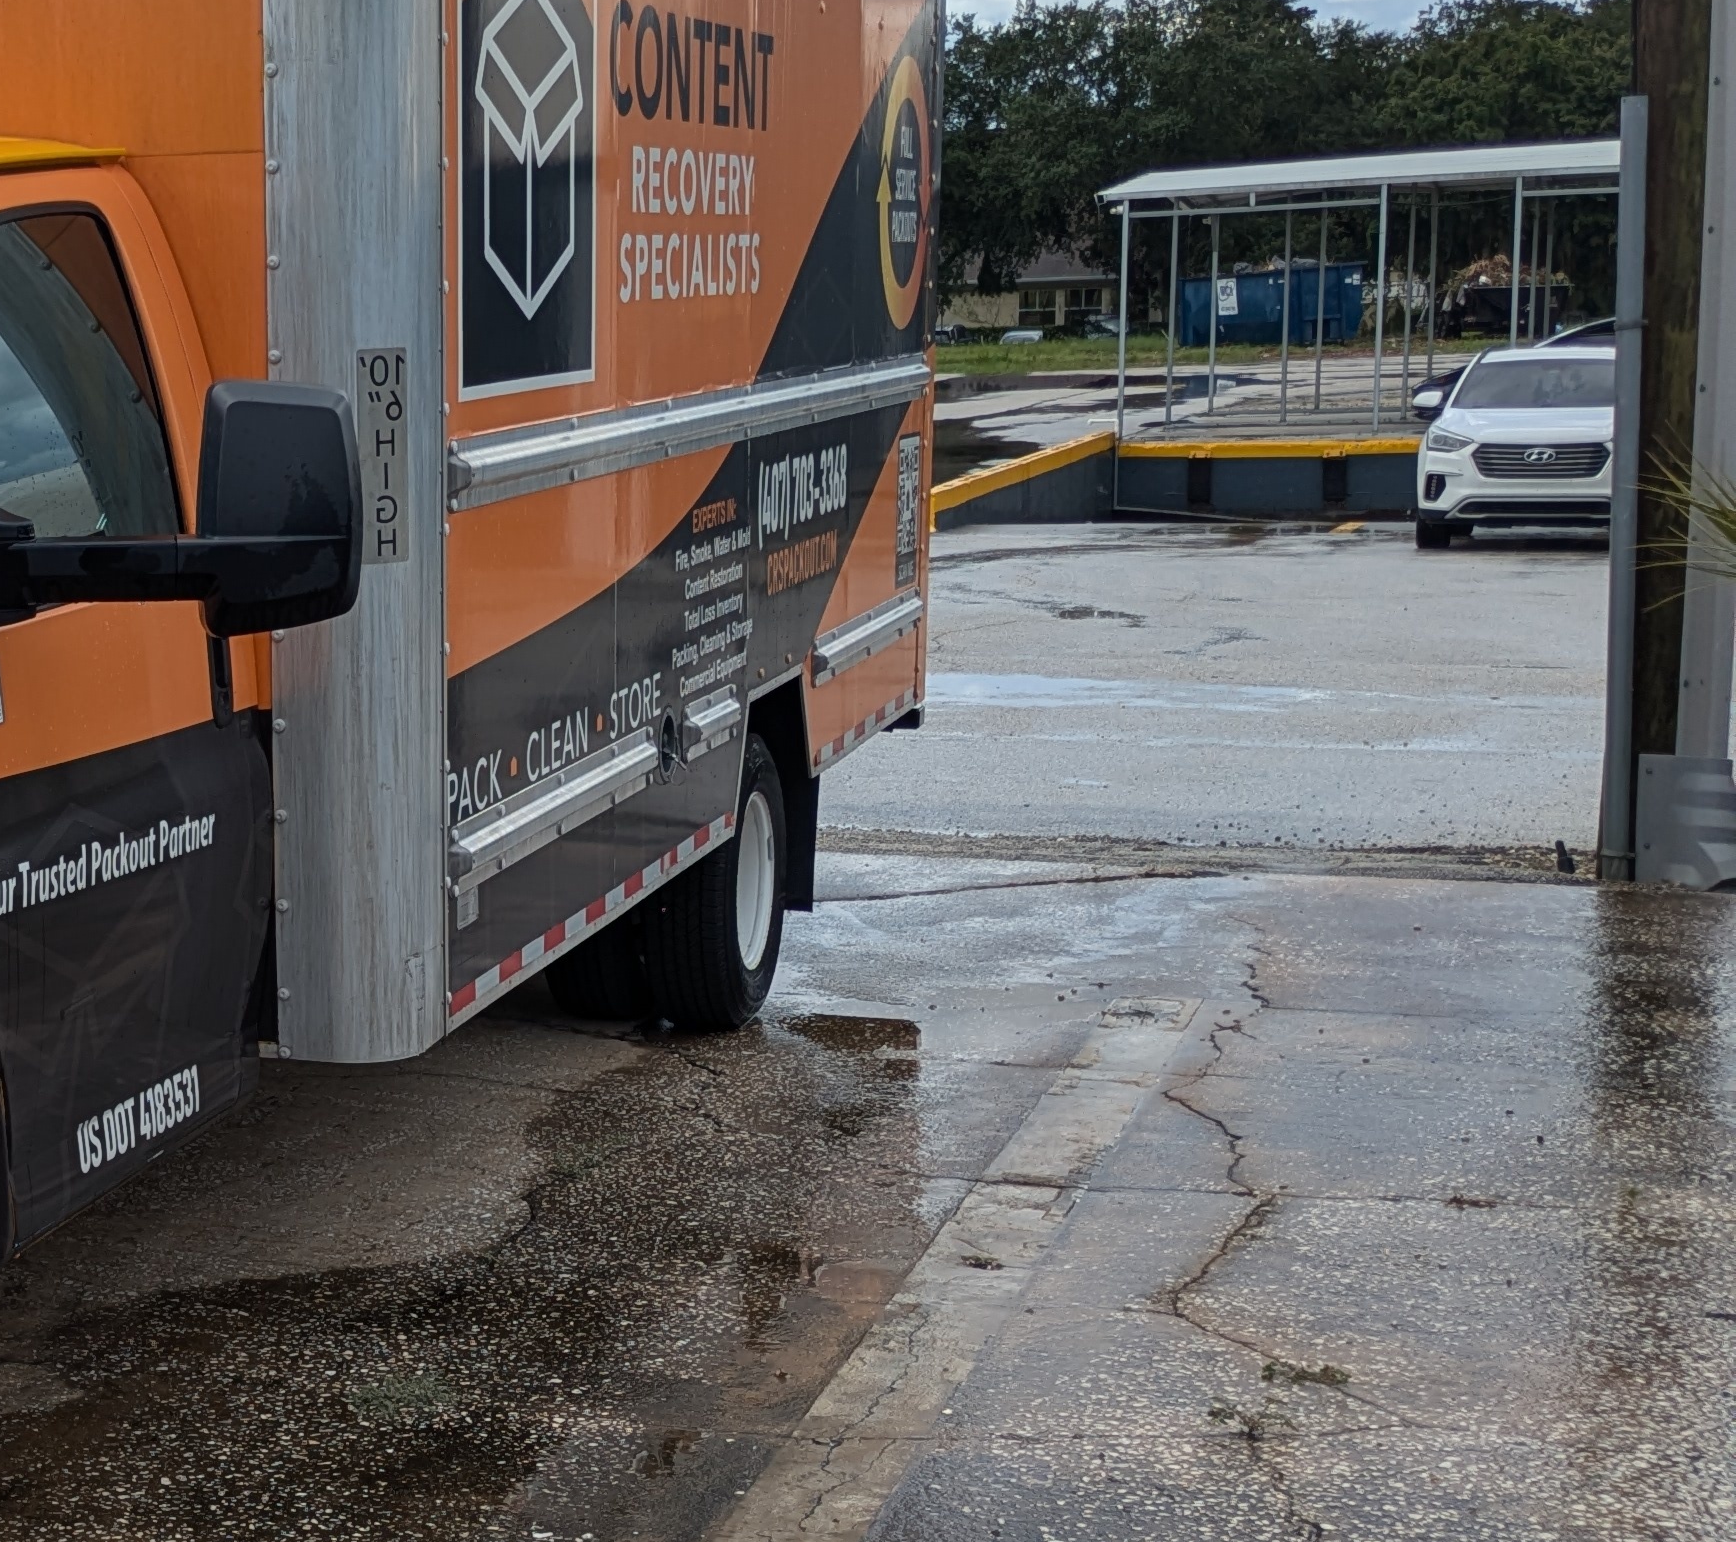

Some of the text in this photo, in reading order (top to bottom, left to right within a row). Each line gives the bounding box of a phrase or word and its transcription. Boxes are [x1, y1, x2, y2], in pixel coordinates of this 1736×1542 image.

[632, 145, 754, 215] RECOVERY
[619, 232, 760, 303] SPECIALISTS
[692, 498, 737, 533] EXPERTS IN:
[758, 443, 847, 551] (407) 703-3368
[675, 525, 751, 572] Fire, Smoke, Water & Mold
[684, 561, 743, 600] Content Restoration
[767, 528, 838, 597] CRSPACKOUT.COM
[672, 618, 753, 670] Packing, Cleaning & Storage
[684, 592, 744, 632] Total Loss Inventory
[680, 653, 747, 698] Commercial Equipment
[447, 672, 662, 826] PACK CLEAN STORE
[18, 844, 87, 909] Trusted
[90, 828, 157, 887] Packout
[158, 813, 216, 863] Partner
[76, 1064, 200, 1174] US DOT 4183531
